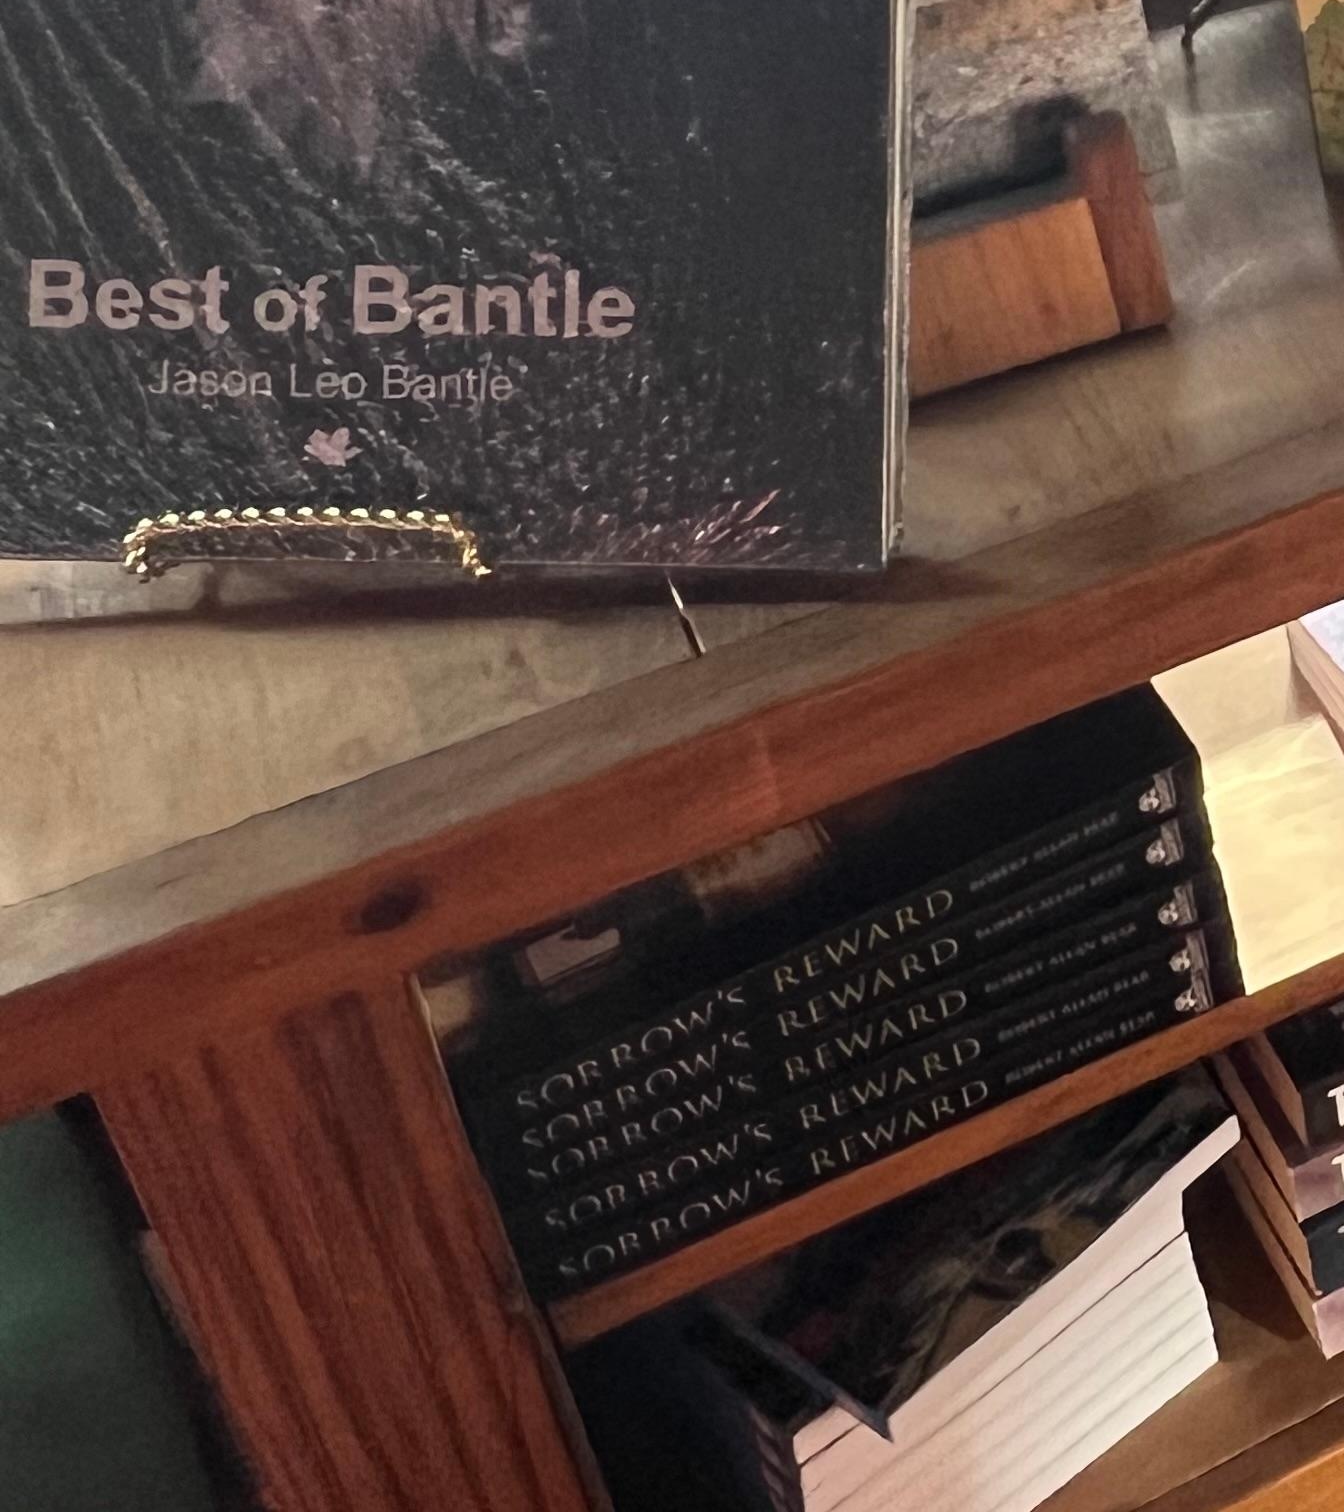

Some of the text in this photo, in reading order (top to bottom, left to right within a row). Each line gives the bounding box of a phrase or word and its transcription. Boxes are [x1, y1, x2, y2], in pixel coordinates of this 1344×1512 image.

[27, 257, 637, 339] Best of Bantle
[146, 360, 514, 406] Jason Leo Bantle
[517, 986, 746, 1109] SORROW'S
[773, 889, 954, 992] REWARD
[522, 937, 959, 1147] SORROW'S REWARD
[784, 990, 968, 1081] REWARD
[545, 1038, 981, 1229] SORROW'S REWARD
[559, 1080, 988, 1276] SORROW'S REWARD
